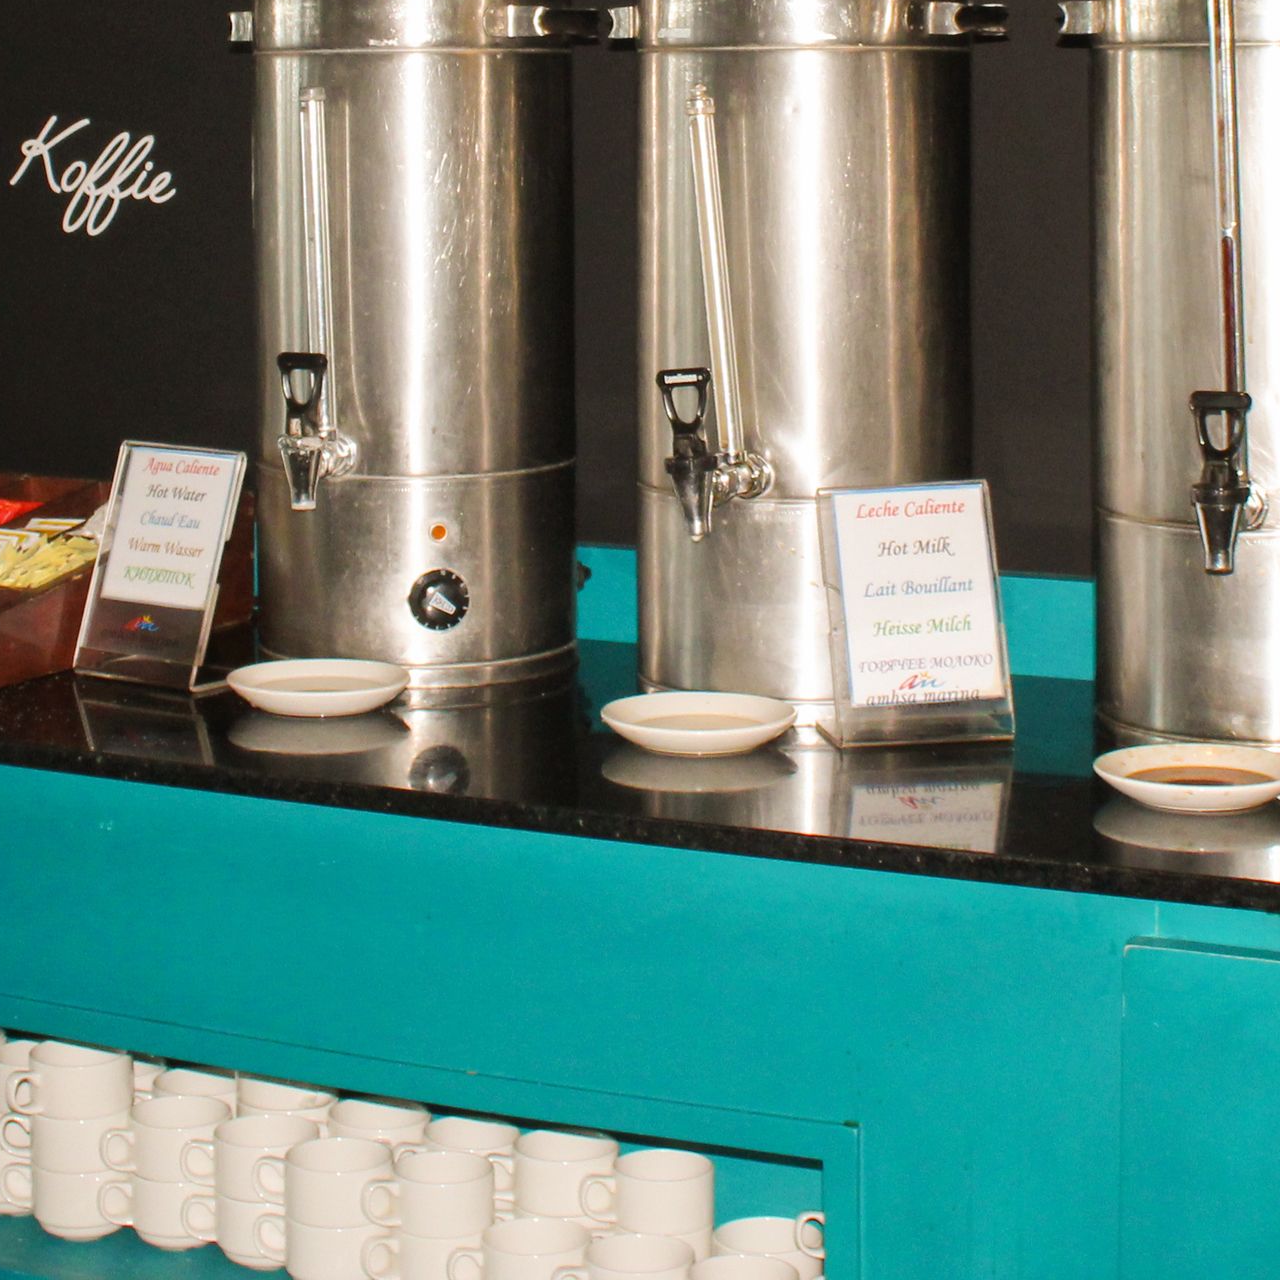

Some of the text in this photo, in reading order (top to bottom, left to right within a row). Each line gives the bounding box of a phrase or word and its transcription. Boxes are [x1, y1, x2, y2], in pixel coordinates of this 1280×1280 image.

[9, 115, 177, 237] Koffie
[143, 457, 220, 477] Agua Caliente
[145, 483, 208, 503] Hot Water
[855, 497, 967, 520] Leche Caliente
[128, 537, 205, 559] Warm Wasser
[877, 535, 956, 558] Hot Milk
[863, 575, 974, 598] Lait Bouillant
[872, 613, 972, 638] Heisse Milch
[866, 688, 917, 707] amhsa
[923, 685, 981, 703] marina
